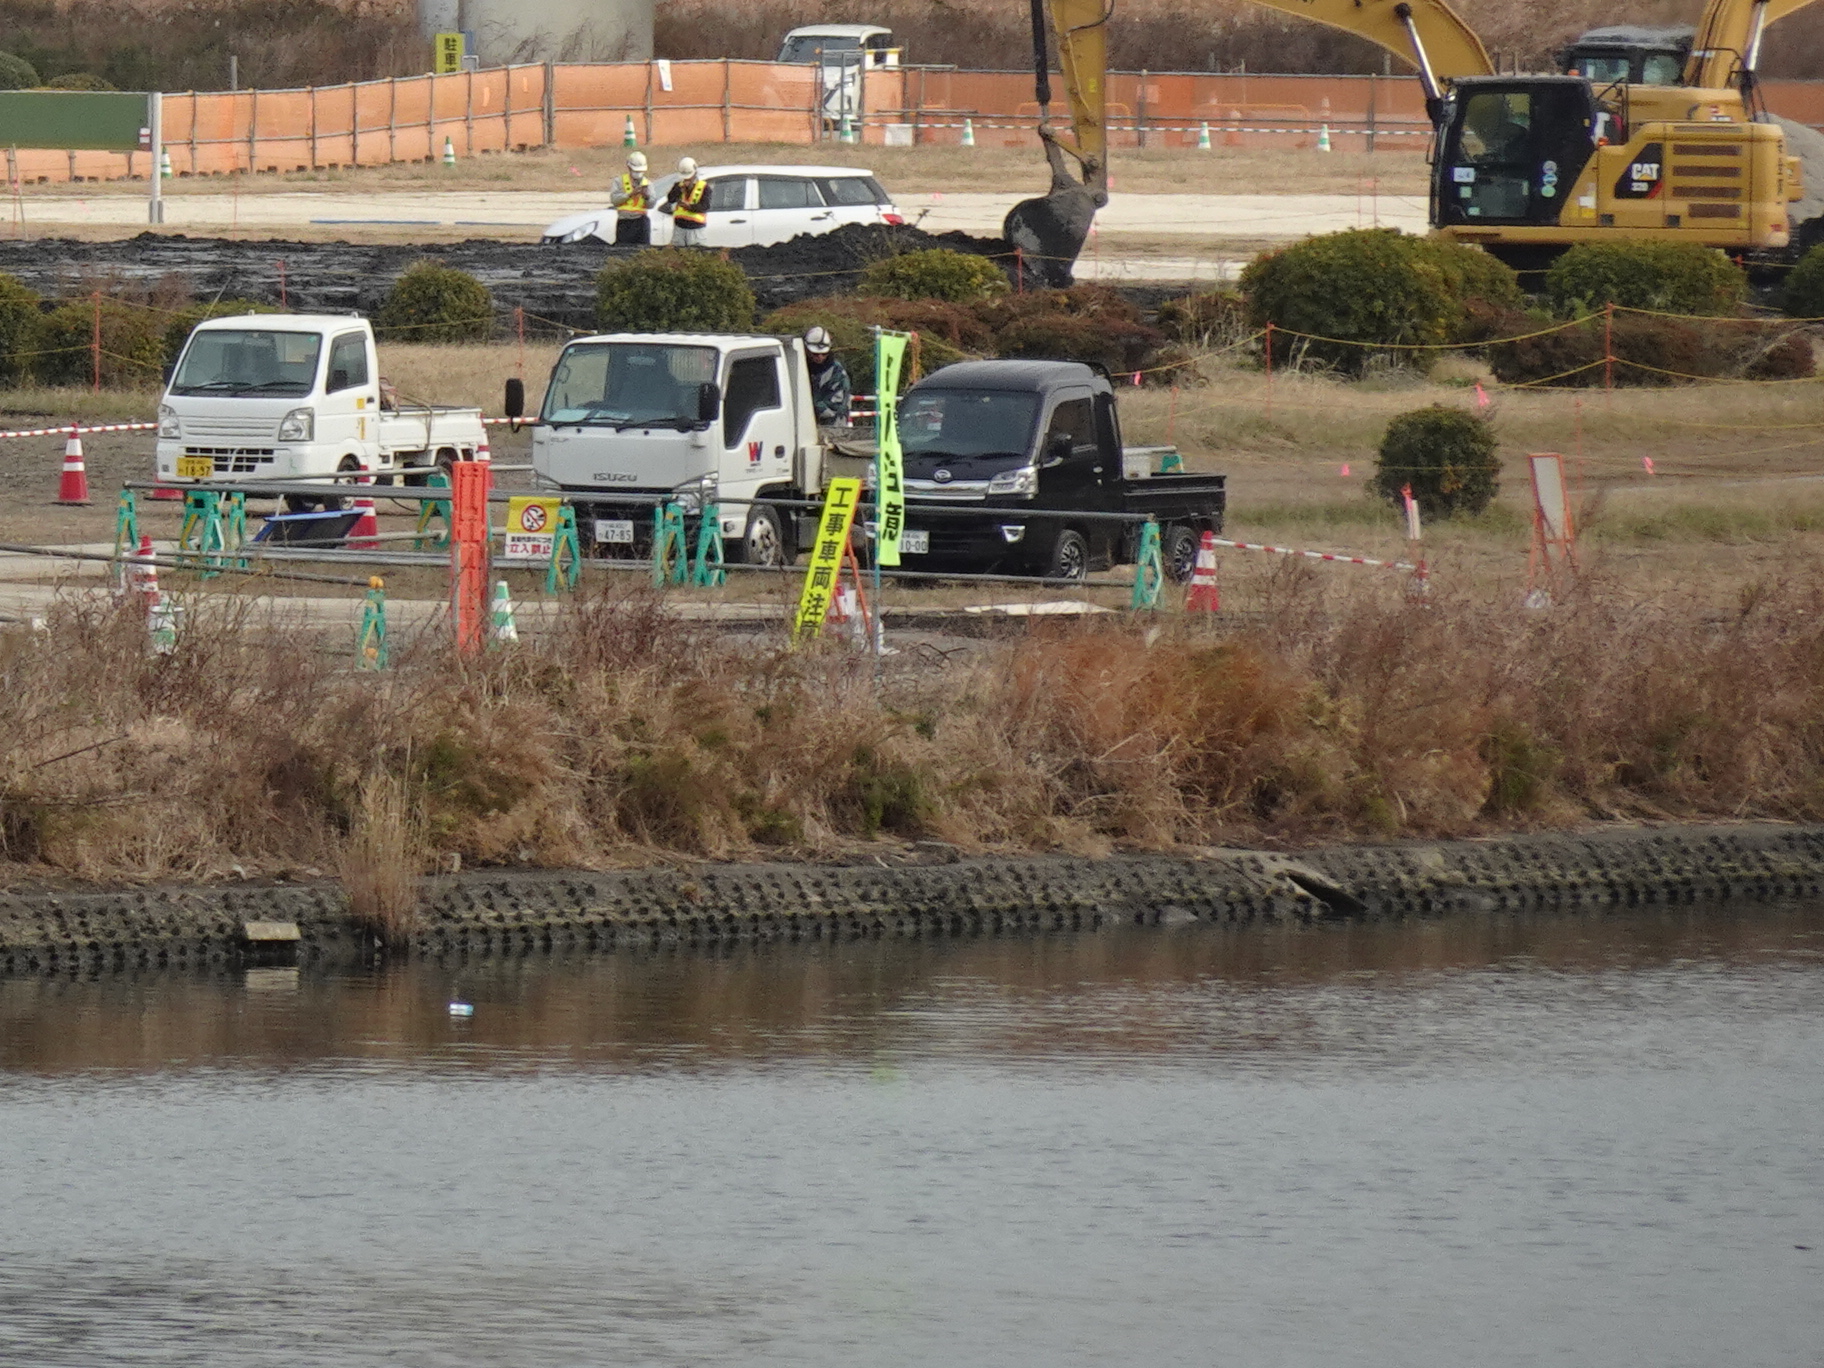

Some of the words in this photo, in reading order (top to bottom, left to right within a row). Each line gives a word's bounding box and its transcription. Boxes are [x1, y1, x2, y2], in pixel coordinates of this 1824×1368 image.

[1631, 163, 1660, 181] CAT
[593, 472, 639, 482] ISUZU
[604, 529, 632, 541] 47-85
[509, 543, 552, 555] 立入禁止
